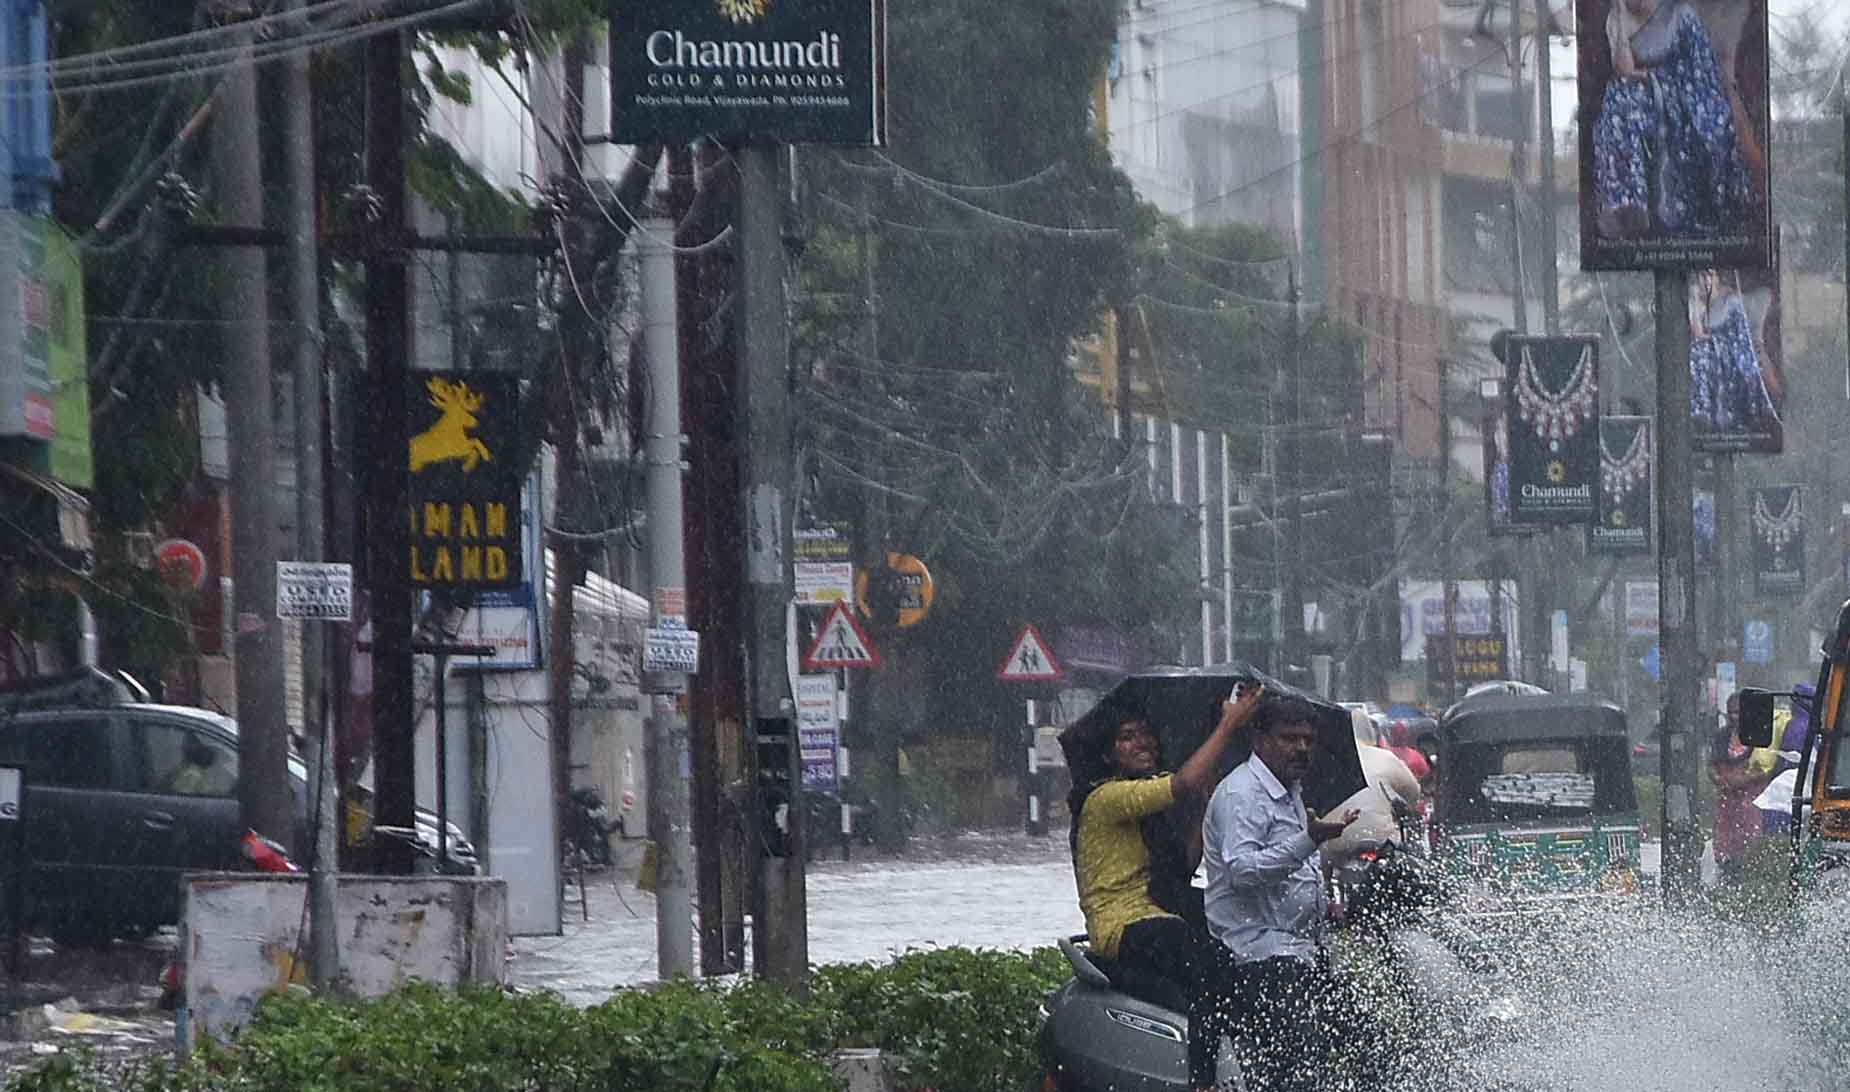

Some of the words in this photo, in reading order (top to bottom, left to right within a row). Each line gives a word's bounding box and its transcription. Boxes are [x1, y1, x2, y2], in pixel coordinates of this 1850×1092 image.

[646, 30, 840, 68] Chamundi
[647, 74, 700, 87] GOLD
[712, 74, 723, 87] &
[736, 74, 845, 87] DIAMONDS
[1521, 484, 1591, 498] Chamundi
[411, 502, 507, 538] MAN
[411, 546, 508, 581] LAND
